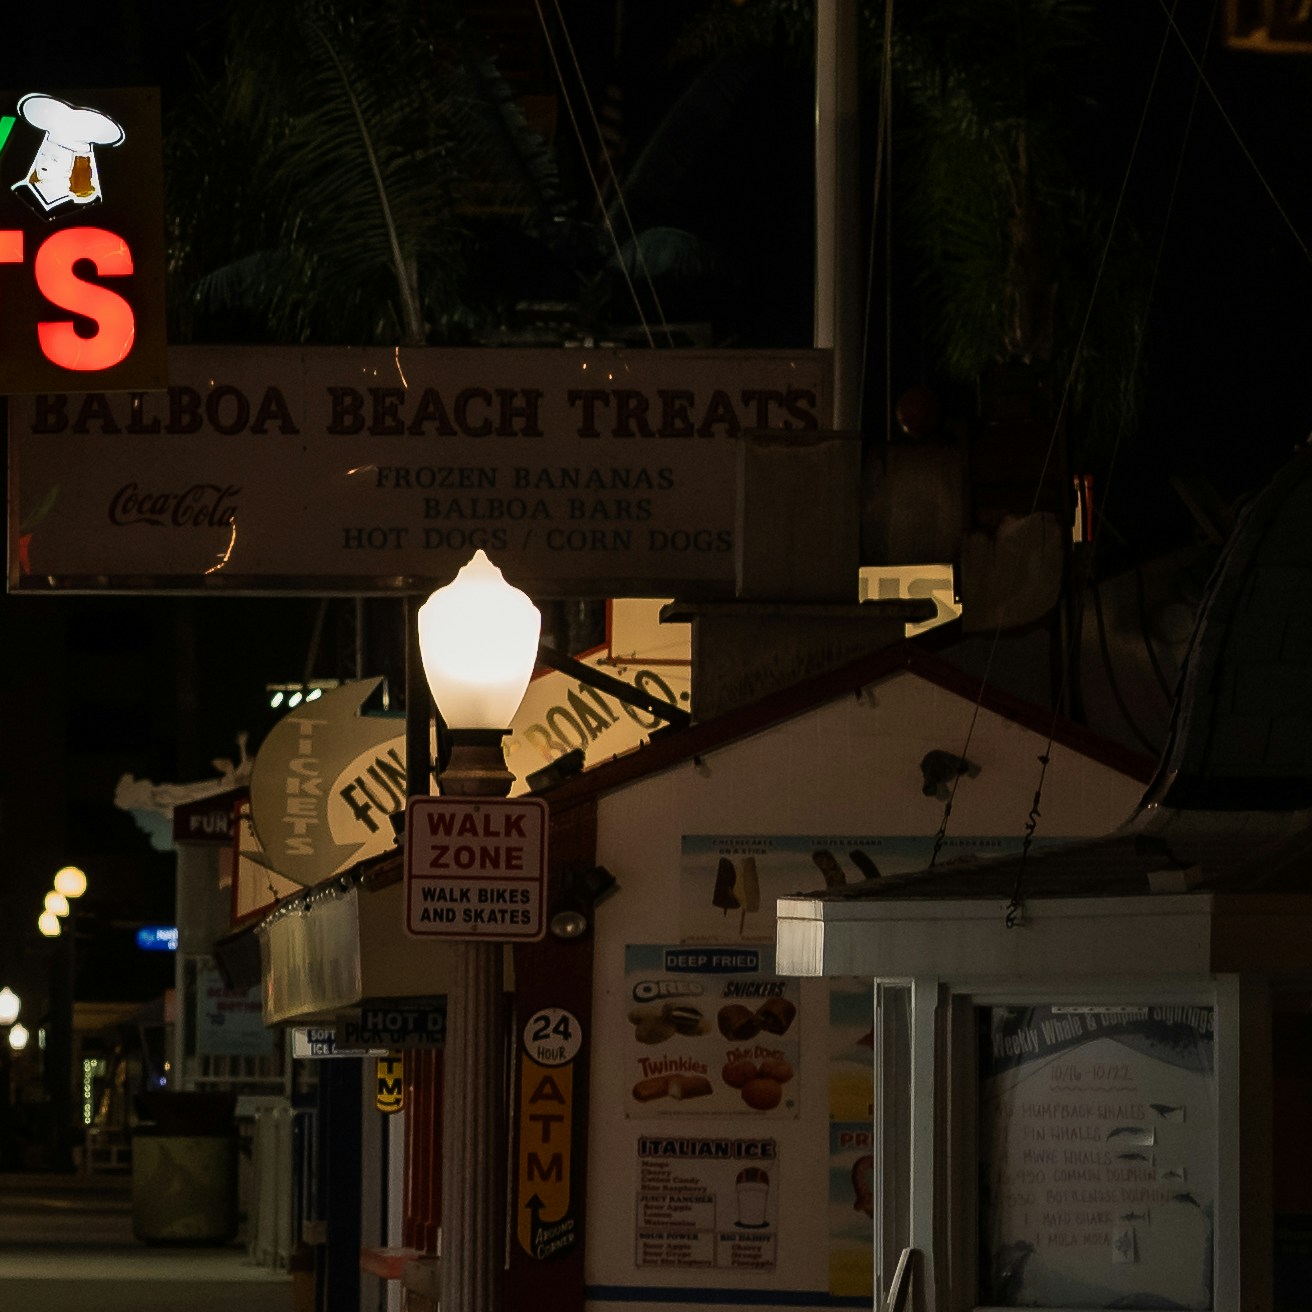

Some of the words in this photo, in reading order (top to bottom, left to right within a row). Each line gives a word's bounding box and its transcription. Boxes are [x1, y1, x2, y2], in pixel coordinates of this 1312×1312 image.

[31, 385, 300, 437] BALBOA
[327, 386, 544, 439] BEACH
[568, 386, 821, 440] TREATS
[375, 466, 497, 489] FROZEN
[513, 466, 675, 490] BANANAS
[106, 481, 243, 528] Coca-Cola
[423, 497, 552, 520] BALBOA
[566, 498, 653, 521] BARS
[342, 527, 408, 550] HOT
[423, 527, 508, 551] DOGS
[546, 528, 632, 551] CORN
[648, 529, 733, 553] DOGS
[426, 811, 527, 838] WALK
[429, 844, 524, 871] ZONE
[422, 886, 471, 903] WALK
[477, 887, 531, 904] BIKES
[420, 907, 456, 923] AND
[462, 908, 531, 925] SKATES
[666, 953, 708, 969] DEEP
[712, 954, 759, 970] FRIED
[723, 980, 786, 998] SNICKERS
[366, 1011, 419, 1030] HOT
[531, 1014, 572, 1043] 24
[1041, 1014, 1083, 1046] Whale
[537, 1046, 567, 1060] HOUR
[638, 1055, 708, 1078] Twinkies
[527, 1074, 566, 1183] ATM
[641, 1140, 729, 1156] ITALIAN
[735, 1141, 773, 1157] ICE
[535, 1219, 575, 1245] AROUND
[536, 1235, 575, 1261] CORNER
